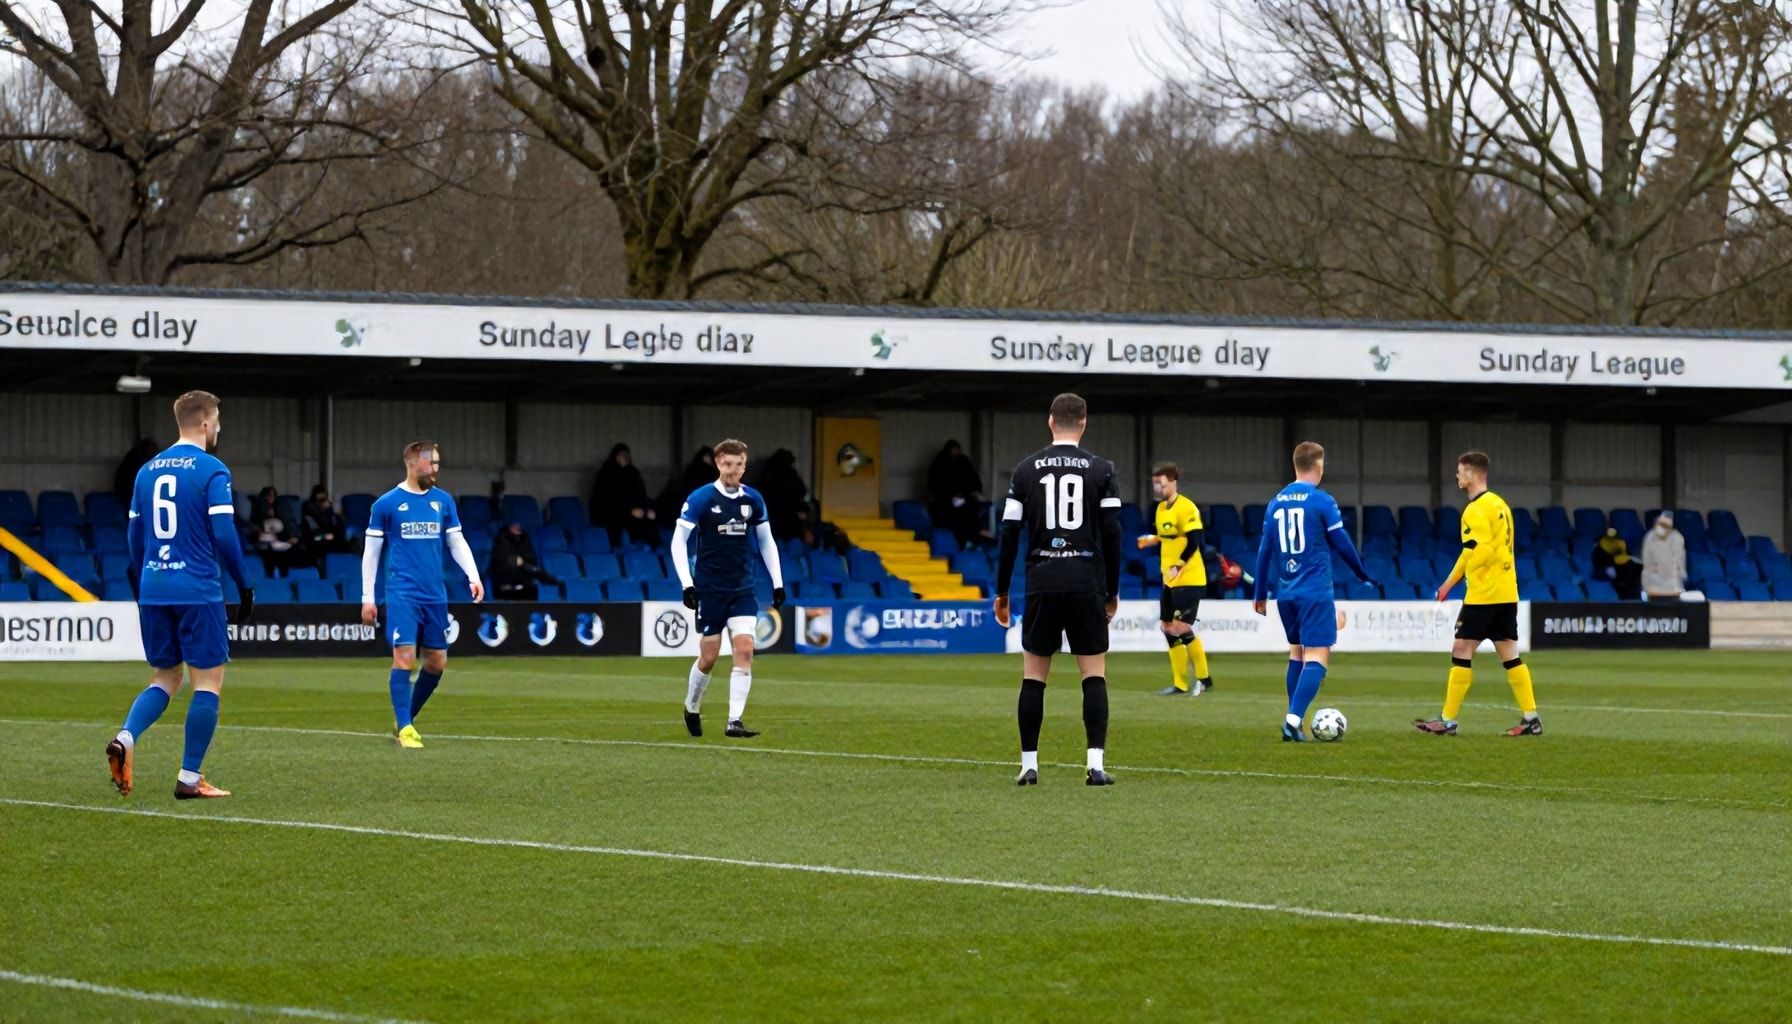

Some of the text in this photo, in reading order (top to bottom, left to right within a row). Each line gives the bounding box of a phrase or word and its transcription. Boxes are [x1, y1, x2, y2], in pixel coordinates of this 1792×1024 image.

[479, 320, 591, 355] Sunday
[991, 335, 1094, 367] Sunday
[1107, 338, 1201, 369] League
[1479, 347, 1686, 381] Sunday League
[152, 474, 178, 540] 6
[1039, 473, 1084, 530] 18
[1273, 507, 1306, 555] 10
